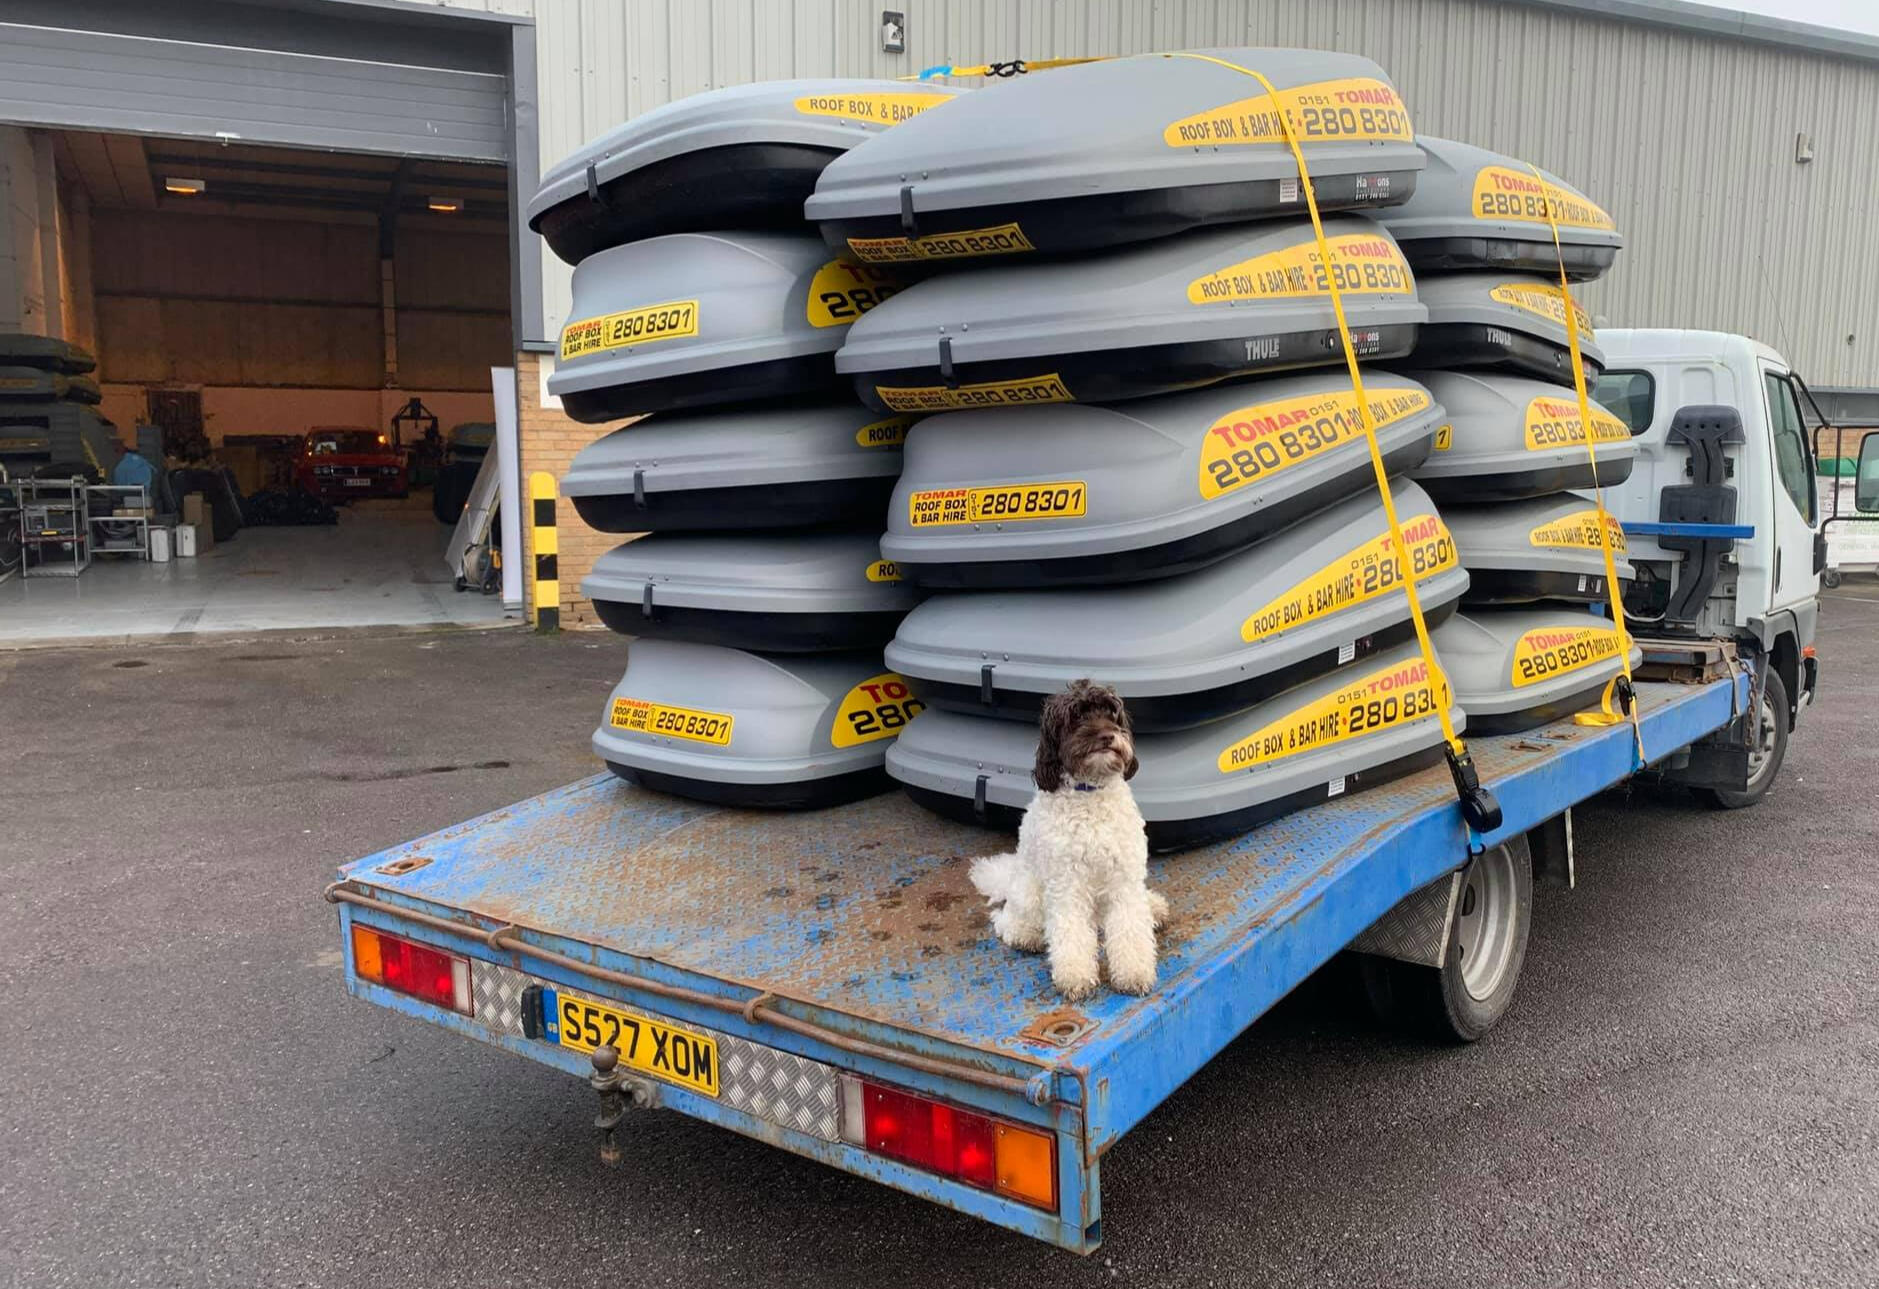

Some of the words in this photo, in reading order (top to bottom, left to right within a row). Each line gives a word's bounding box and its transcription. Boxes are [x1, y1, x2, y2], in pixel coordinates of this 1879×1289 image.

[1298, 95, 1329, 106] 0151
[1335, 87, 1395, 105] TOMAR
[810, 98, 845, 111] ROOF
[849, 101, 873, 117] BOX
[880, 103, 888, 119] &
[1179, 121, 1211, 141] ROOF
[1214, 118, 1237, 139] BOX
[1240, 116, 1248, 137] &
[1250, 113, 1271, 136] BAR
[1272, 108, 1296, 136] HIE
[1304, 108, 1356, 135] 280
[1361, 109, 1409, 136] 8301
[1480, 192, 1522, 215] 280
[922, 240, 964, 256] 280
[967, 230, 1024, 251] 8301
[1338, 240, 1393, 259] TOMAR
[1309, 251, 1337, 262] 011
[1201, 279, 1232, 298] ROOF
[1233, 276, 1256, 294] BOX
[1260, 274, 1267, 294] &
[1268, 270, 1287, 292] BAR
[1287, 265, 1309, 292] HIRE
[1314, 263, 1361, 291] 280
[1363, 264, 1410, 289] 8301
[566, 331, 583, 343] ROOF
[585, 326, 602, 339] BOX
[613, 315, 644, 340] 280
[646, 308, 691, 334] 8301
[583, 338, 601, 350] HIRE
[1245, 338, 1280, 361] THULE
[957, 390, 1001, 405] 280
[1003, 382, 1064, 402] 8301
[869, 425, 898, 442] ROOF
[1212, 409, 1309, 448] TOMAR
[1309, 400, 1338, 415] 0151
[1530, 421, 1566, 445] 280
[1566, 419, 1599, 440] 831
[1208, 441, 1280, 489] 280
[1279, 414, 1351, 459] 8301
[1368, 401, 1390, 423] BOX
[914, 490, 967, 501] TOMAR
[915, 500, 941, 512] ROOF
[945, 499, 967, 510] BOX
[981, 493, 1020, 515] 280
[1024, 488, 1082, 512] 8301
[921, 513, 939, 524] BAR
[943, 510, 966, 522] HIRE
[1586, 526, 1602, 546] 28
[1608, 530, 1625, 550] 830
[878, 563, 899, 577] RO
[1351, 553, 1379, 570] 0151
[1253, 615, 1281, 635] ROOF
[1284, 603, 1303, 625] BOX
[1307, 595, 1314, 615] &
[1317, 587, 1334, 611] BAR
[1335, 572, 1355, 606] HIRE
[1413, 536, 1454, 574] 8301
[1525, 633, 1575, 652] TOMAR
[1520, 652, 1558, 678] 280
[1558, 640, 1594, 667] 8301
[1367, 662, 1429, 694] TOMAR
[1337, 688, 1367, 704] 0151
[614, 706, 632, 716] ROOF
[632, 708, 648, 719] BOX
[616, 716, 628, 726] BAR
[629, 718, 647, 729] HIRE
[655, 711, 685, 730] 280
[685, 715, 729, 739] 8301
[1231, 743, 1261, 765] ROOF
[1264, 732, 1284, 756] BOX
[1289, 728, 1296, 748] &
[1299, 719, 1317, 746] BAR
[1319, 711, 1339, 740] HIRE
[1350, 697, 1398, 733] 280
[563, 1002, 640, 1059] S527
[650, 1025, 711, 1086] XOM
